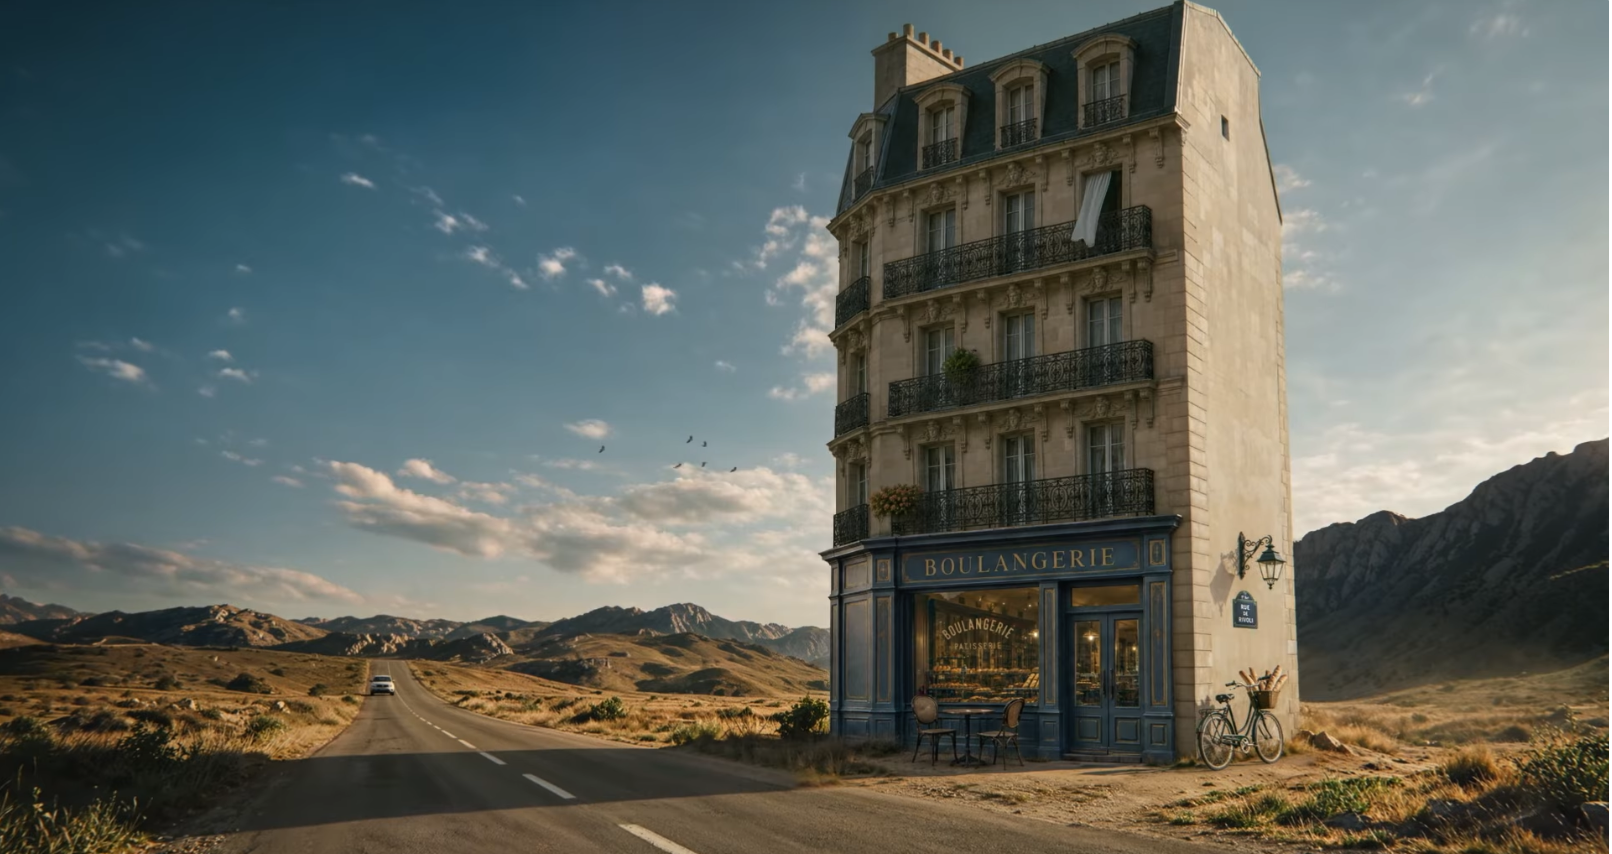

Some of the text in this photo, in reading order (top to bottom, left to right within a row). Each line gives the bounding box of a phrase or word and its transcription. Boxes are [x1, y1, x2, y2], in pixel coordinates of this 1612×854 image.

[925, 548, 1115, 576] BOULANGERIE
[942, 618, 1014, 640] BOULANGERIE
[954, 642, 1002, 650] PATISSERIE
